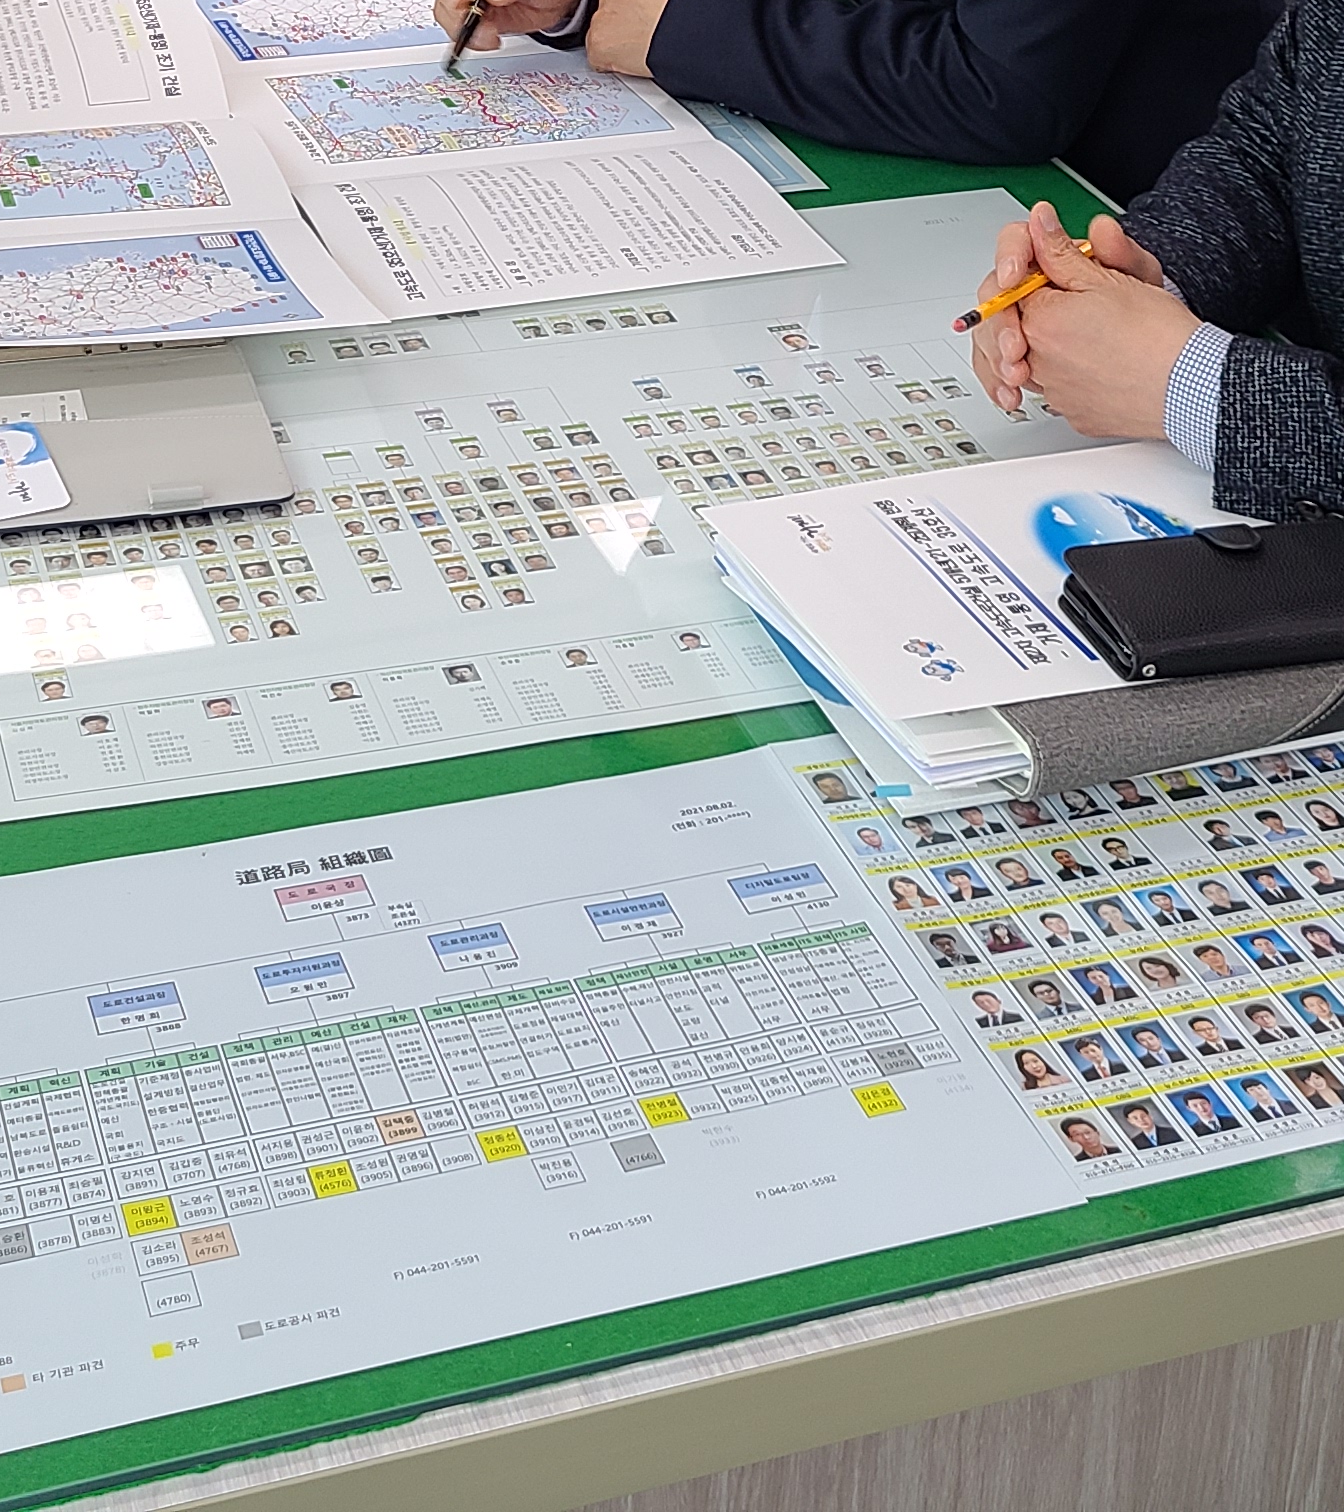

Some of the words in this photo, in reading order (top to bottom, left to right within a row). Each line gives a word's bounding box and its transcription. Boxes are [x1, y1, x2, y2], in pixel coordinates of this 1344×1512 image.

[160, 75, 183, 97] 건설
[392, 268, 426, 301] 고속도로
[909, 506, 959, 541] 35호선
[947, 541, 1006, 588] 고속도로
[235, 859, 311, 886] 道路局
[319, 845, 394, 872] 組織圖
[806, 900, 830, 911] 4130
[345, 912, 370, 923] 3873
[494, 961, 519, 972] 3909
[102, 990, 167, 1008] 도로건설과장
[325, 991, 350, 1002] 3897
[866, 1098, 899, 1112] (4132)
[651, 1108, 684, 1123] (3923)
[426, 1118, 460, 1133] (3906)
[55, 1138, 82, 1151] R&D
[60, 1152, 96, 1167] 휴게소
[217, 1160, 252, 1175] (4768)
[124, 1178, 159, 1193] (3891)
[318, 1178, 353, 1193] (4576)
[768, 1173, 838, 1198] 044-201-5592
[71, 1188, 107, 1203] (3874)
[229, 1196, 264, 1211] (3892)
[582, 1213, 654, 1239] 044-201-5591
[141, 1239, 178, 1255] 김소라
[194, 1243, 230, 1259] (4767)
[144, 1253, 181, 1269] (3895)
[406, 1253, 482, 1279] 044-201-5591
[156, 1293, 193, 1309] (4780)
[263, 1312, 314, 1332] 도로공사
[316, 1306, 342, 1321] 파견
[174, 1336, 201, 1352] 주무
[49, 1365, 75, 1380] 기관
[78, 1359, 105, 1375] 파견
